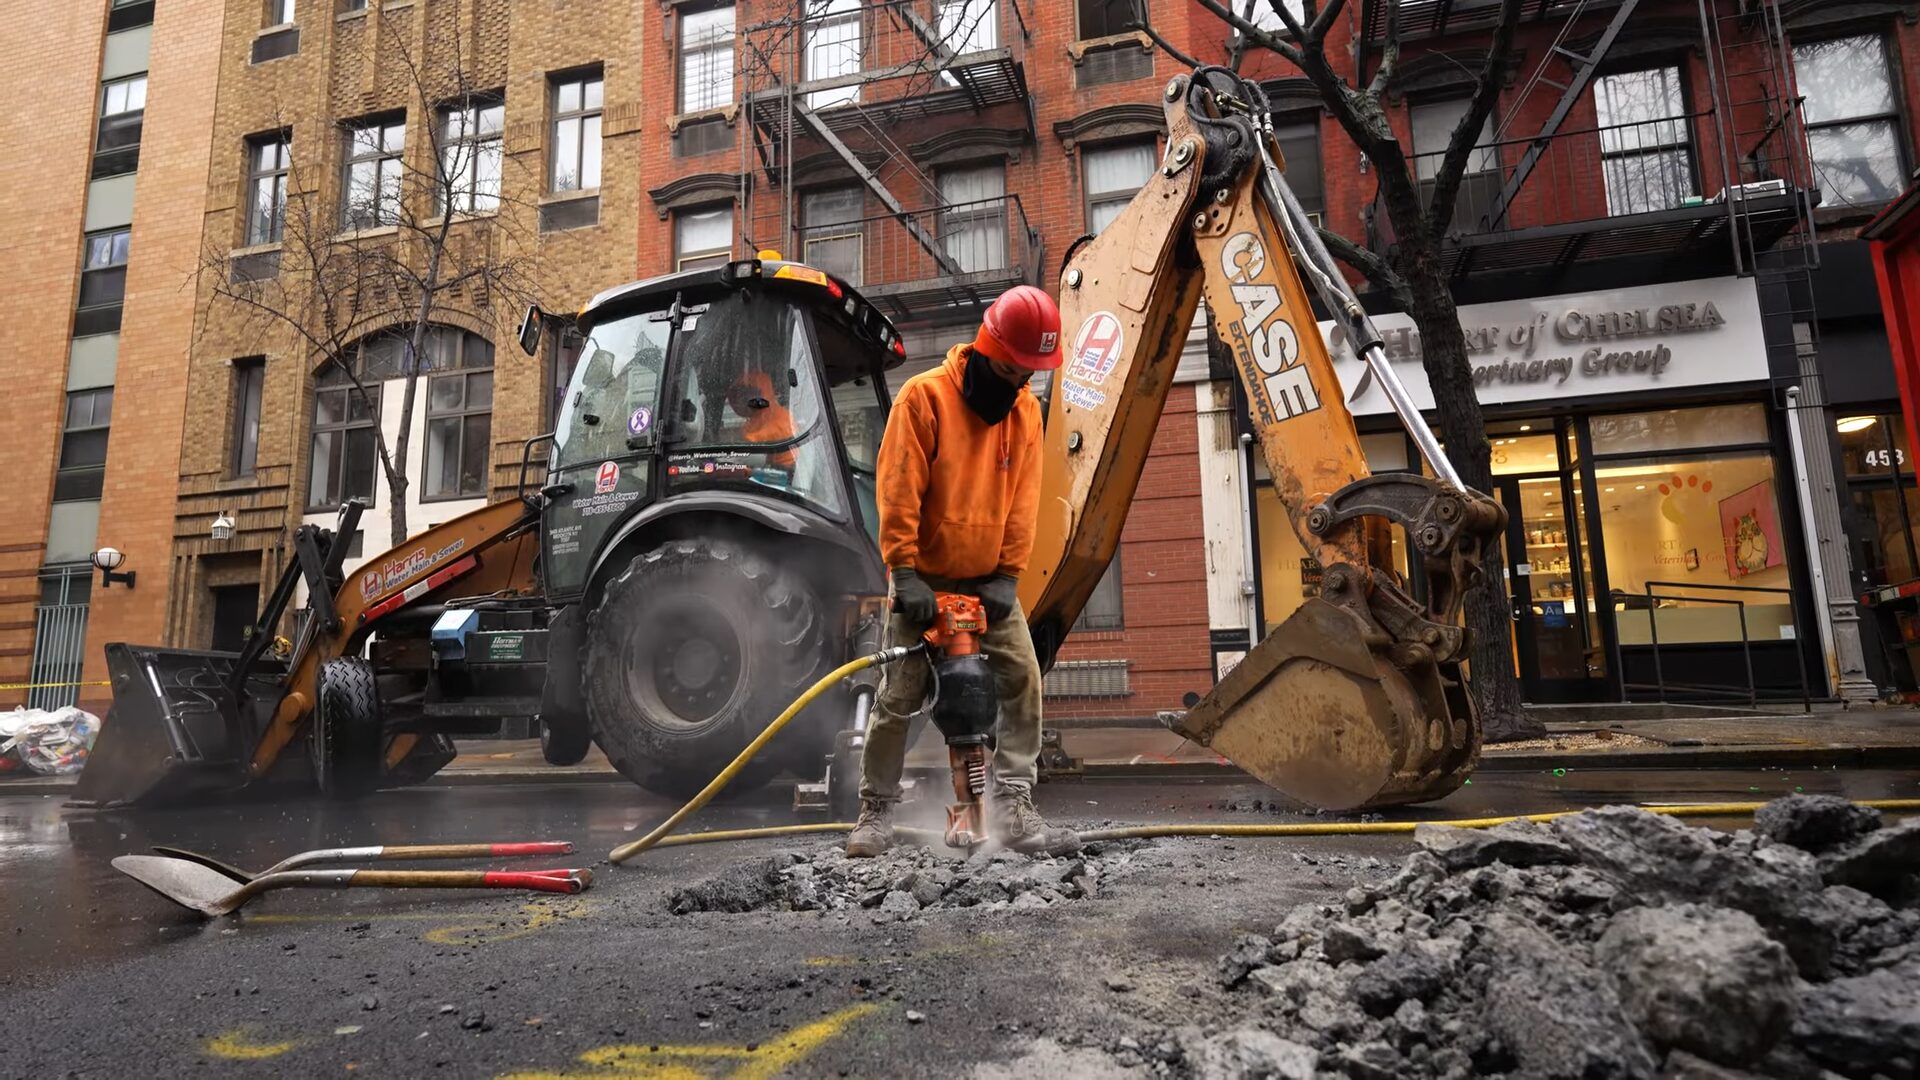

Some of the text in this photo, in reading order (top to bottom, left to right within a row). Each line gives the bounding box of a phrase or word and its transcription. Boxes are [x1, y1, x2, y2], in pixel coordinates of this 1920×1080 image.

[1221, 231, 1321, 422] CASE
[1508, 311, 1548, 357] of
[1555, 301, 1726, 343] CHELSEA
[1067, 357, 1105, 383] Harris
[1229, 320, 1273, 427] EXTENDAHOE
[1473, 343, 1672, 385] erinary Group
[1062, 379, 1106, 404] Water Main
[1072, 393, 1097, 410] Sewer
[715, 463, 748, 473] Instagram
[615, 491, 639, 502] Sewer
[383, 547, 426, 581] Harris
[384, 570, 410, 590] Water
[411, 560, 431, 575] Main
[438, 538, 465, 559] Sewer
